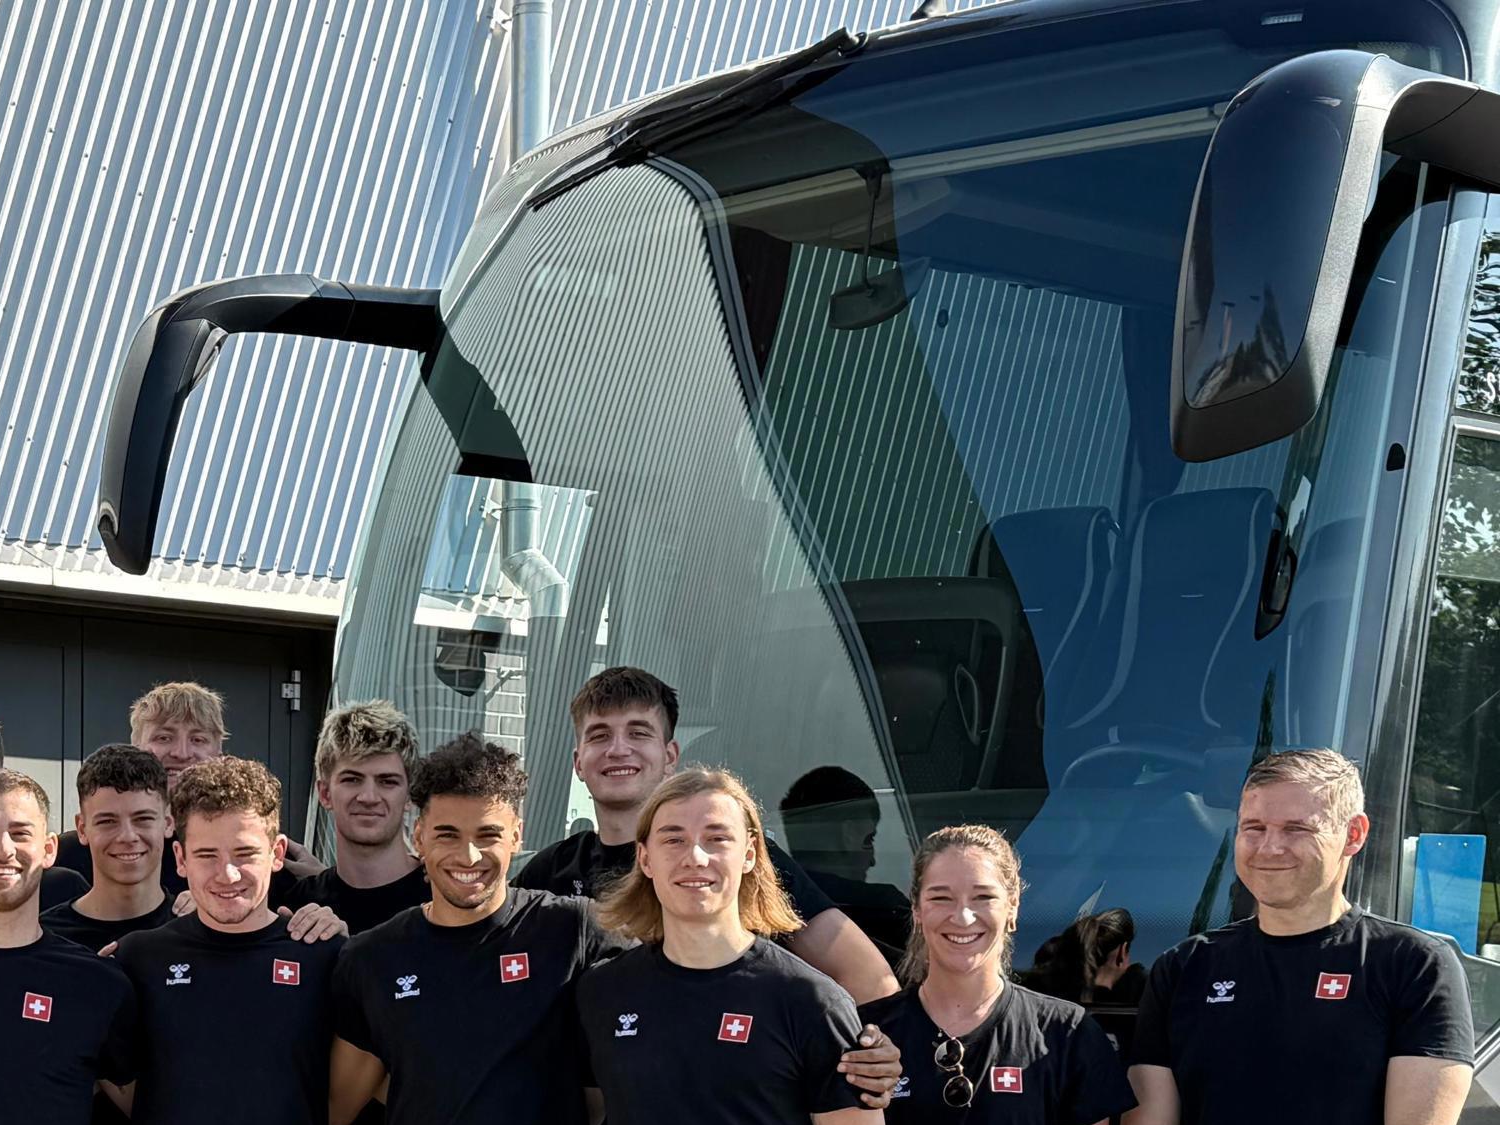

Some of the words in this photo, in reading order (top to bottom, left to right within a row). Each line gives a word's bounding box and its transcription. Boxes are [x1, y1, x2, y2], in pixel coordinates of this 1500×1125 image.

[166, 976, 191, 986] hummel
[395, 988, 421, 1000] hummel
[1207, 994, 1235, 1004] hummel
[615, 1028, 638, 1038] hummel
